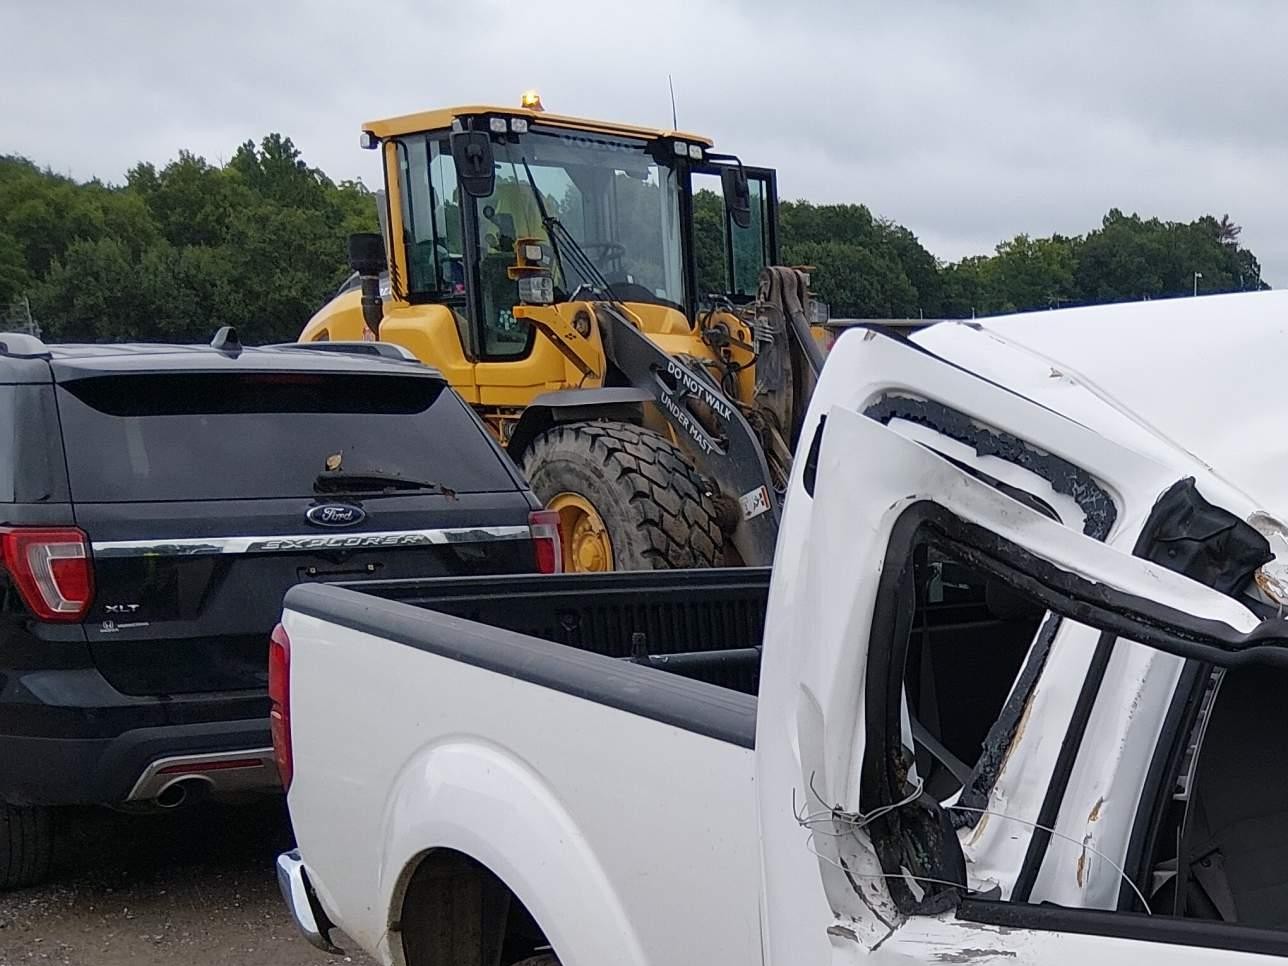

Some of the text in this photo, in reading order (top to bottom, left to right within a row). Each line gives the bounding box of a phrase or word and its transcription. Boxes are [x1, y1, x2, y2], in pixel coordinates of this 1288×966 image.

[668, 362, 732, 422] DO NOT WALK
[660, 392, 714, 455] UNDER MAST
[321, 507, 354, 521] Ford
[260, 535, 424, 550] EXPLORER
[105, 604, 140, 613] XLT
